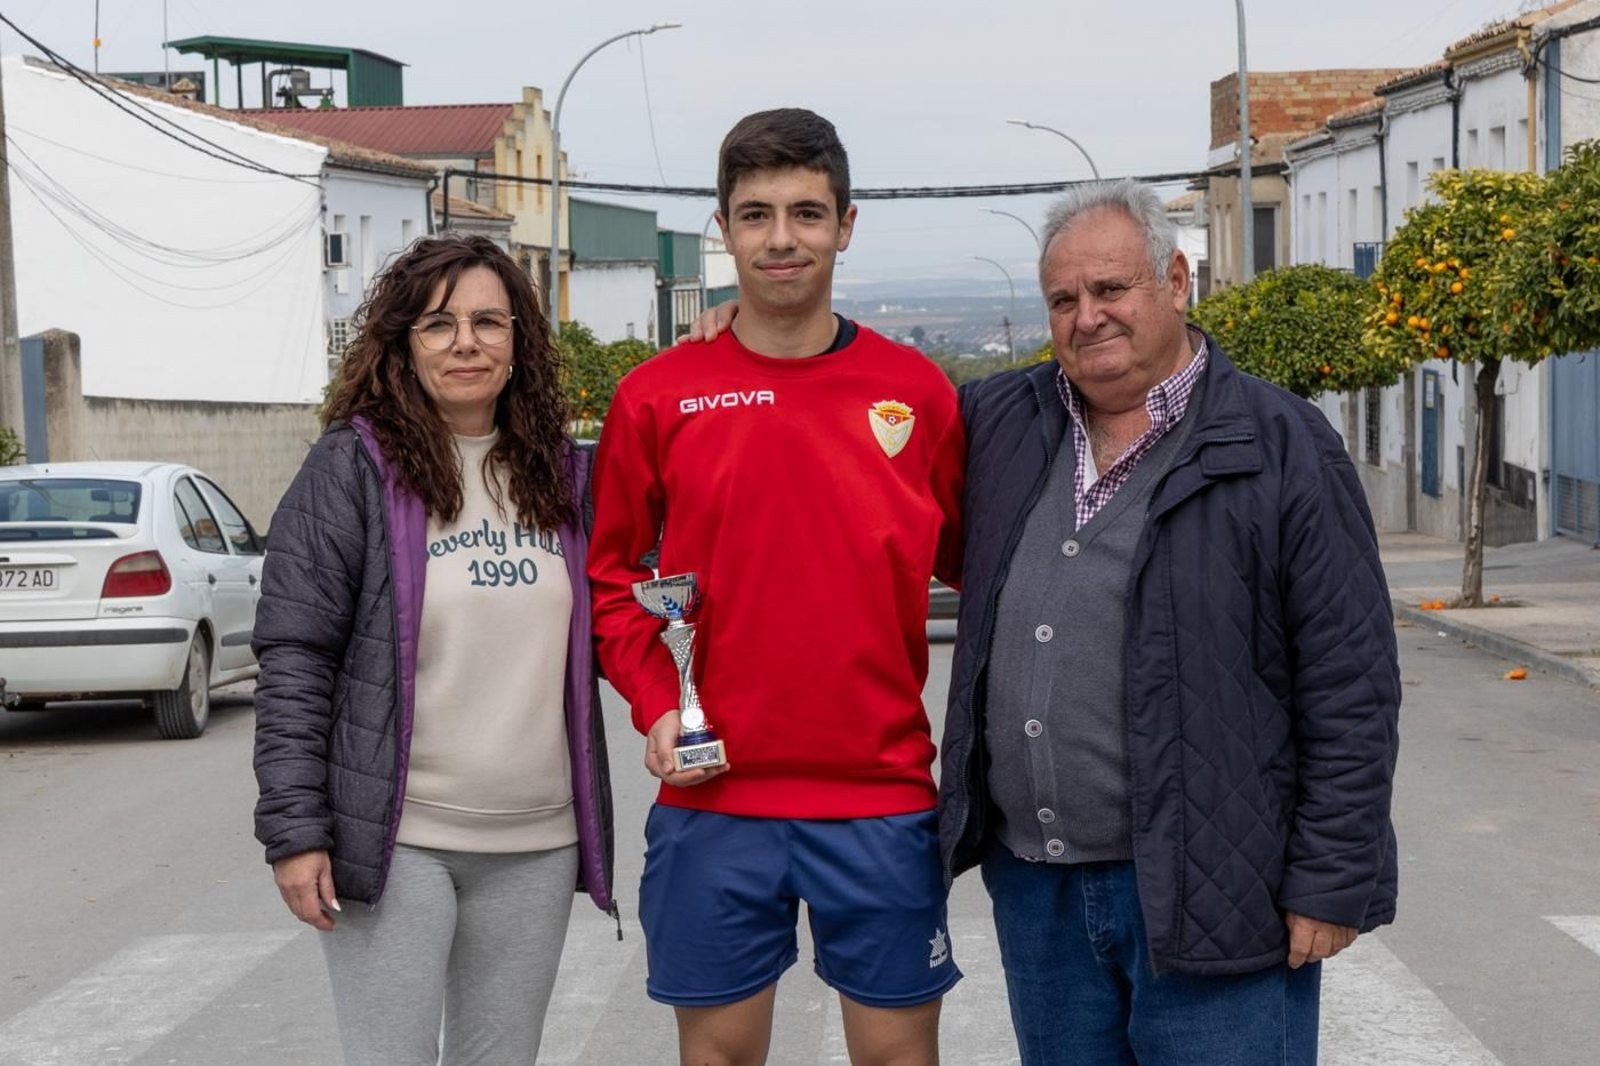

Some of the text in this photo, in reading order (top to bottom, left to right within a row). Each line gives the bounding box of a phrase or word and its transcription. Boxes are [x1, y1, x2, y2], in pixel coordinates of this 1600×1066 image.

[680, 390, 775, 414] GIVOVA
[427, 518, 507, 558] everly
[0, 569, 54, 588] 72 AD
[467, 557, 538, 587] 1990
